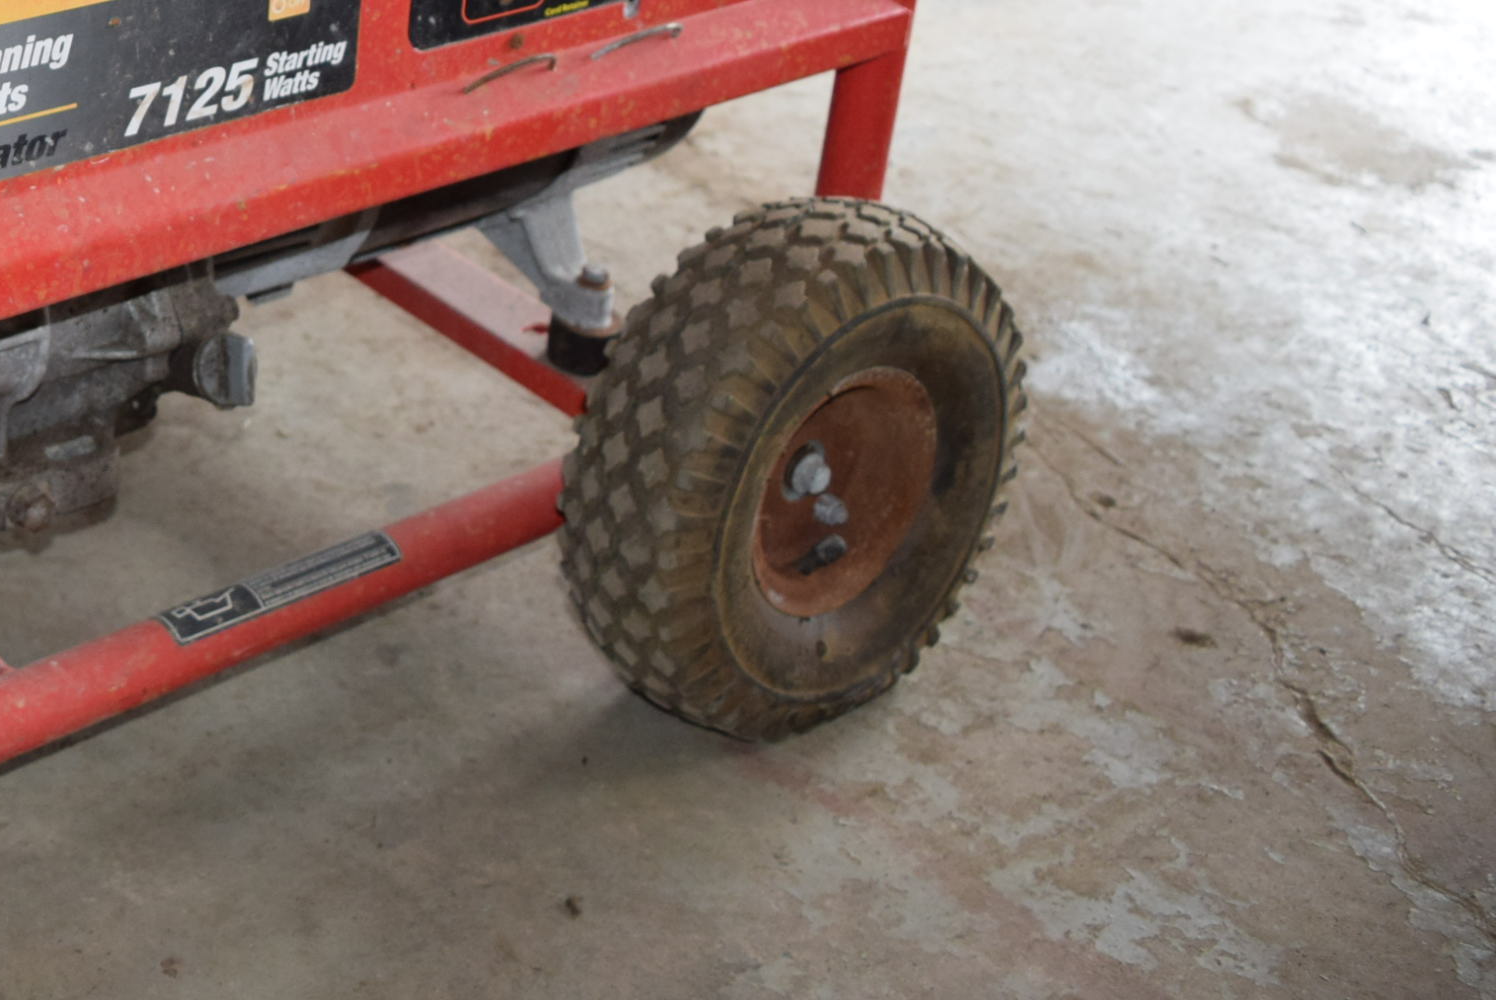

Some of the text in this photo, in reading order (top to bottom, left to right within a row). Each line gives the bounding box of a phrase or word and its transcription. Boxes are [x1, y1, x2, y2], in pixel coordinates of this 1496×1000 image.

[124, 40, 348, 137] 7125 Starting
[262, 69, 321, 101] Watts
